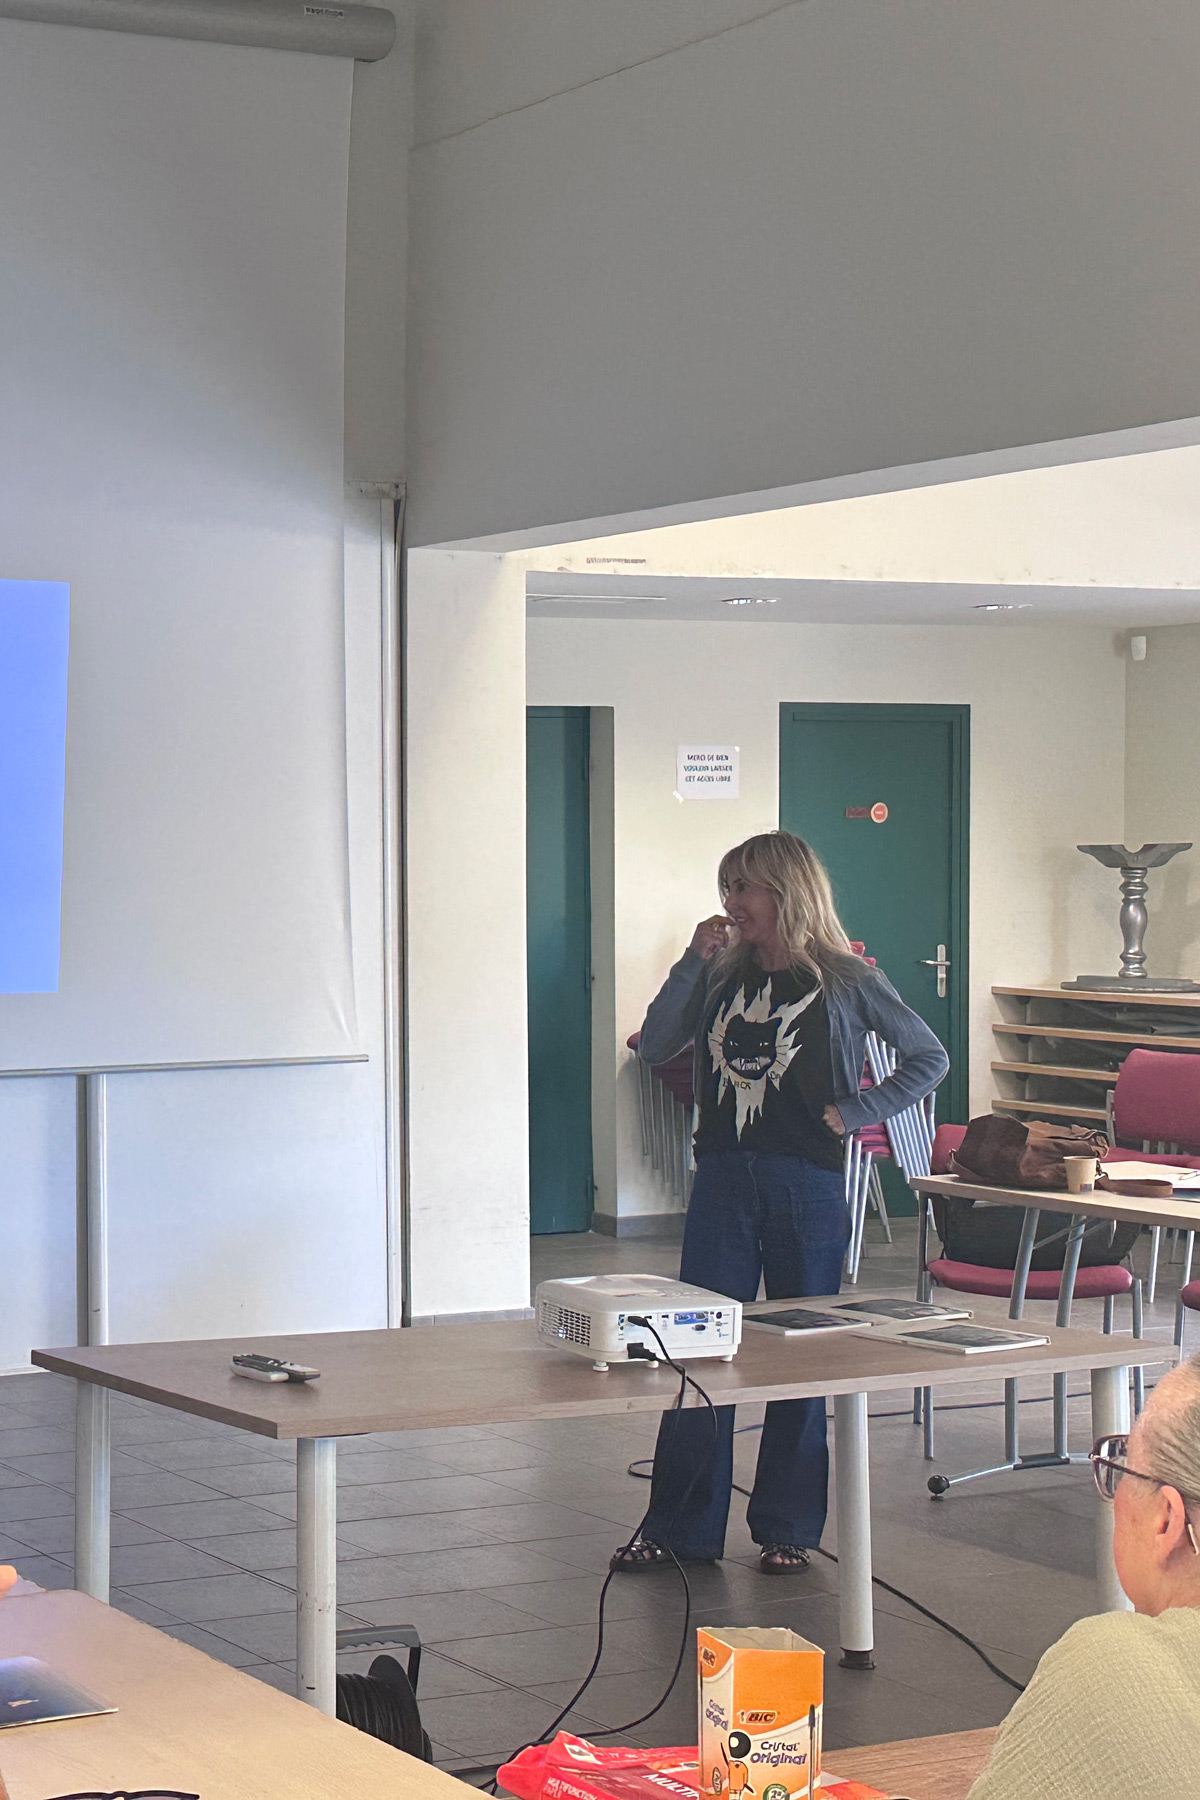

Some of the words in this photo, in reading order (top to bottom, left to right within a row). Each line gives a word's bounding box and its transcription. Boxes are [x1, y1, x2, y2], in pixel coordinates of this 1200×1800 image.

[748, 1711, 774, 1722] BIC
[760, 1741, 799, 1752] Cristal
[750, 1752, 808, 1767] Original
